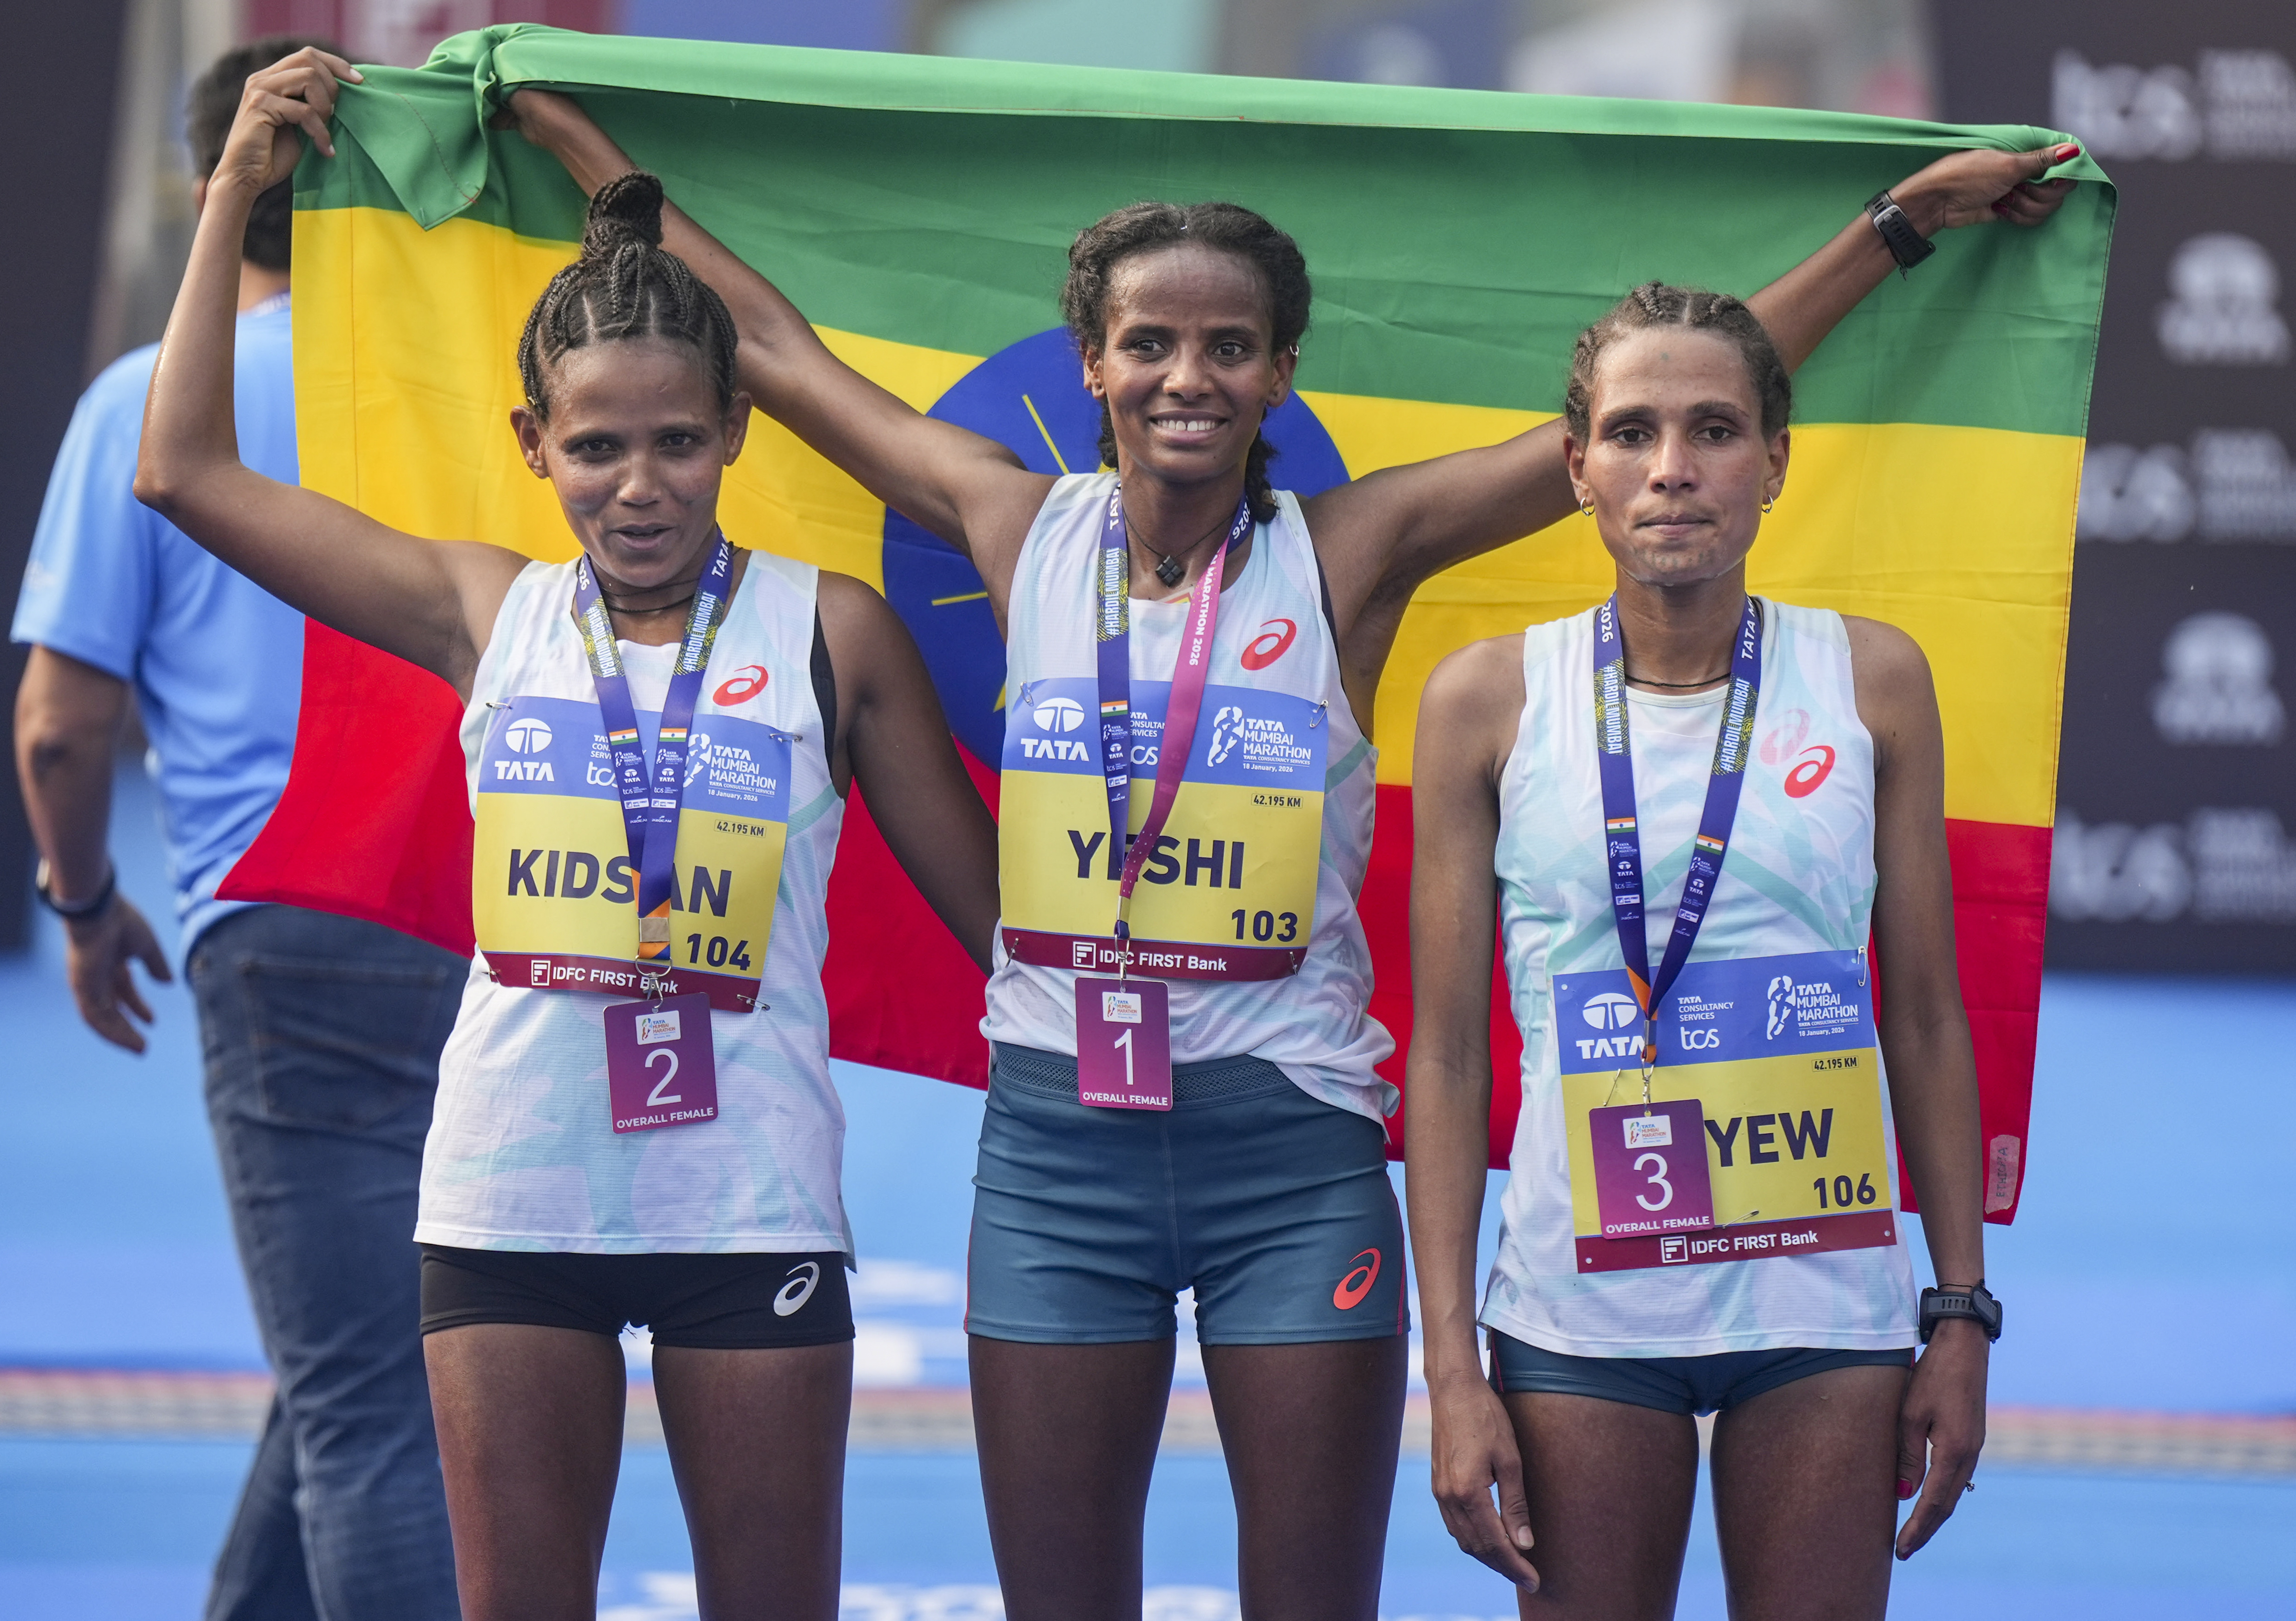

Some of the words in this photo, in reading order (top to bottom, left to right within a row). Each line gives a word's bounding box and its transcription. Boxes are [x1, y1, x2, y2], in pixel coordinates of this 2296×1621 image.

[1195, 566, 1214, 635] MARATHON
[1601, 601, 1614, 643] 2026
[1741, 620, 1756, 660] TATA
[1189, 638, 1203, 666] 2026
[1130, 712, 1148, 720] ATA
[1130, 729, 1158, 737] RVICES
[1247, 719, 1285, 733] TATA
[1245, 730, 1293, 745] MUMBAI
[714, 745, 751, 761] TATA
[1021, 738, 1089, 762] TATA
[1130, 745, 1159, 766] cs
[1244, 743, 1311, 760] MARATHON
[495, 760, 555, 782] TATA
[711, 756, 760, 775] MUMBAI
[1251, 764, 1278, 773] January,
[709, 768, 777, 790] MARATHON
[723, 783, 755, 792] CONSULTANCY
[715, 790, 742, 800] January,
[1254, 795, 1285, 806] 42.195
[1287, 797, 1301, 808] KM
[717, 821, 748, 834] 42.195
[750, 826, 764, 836] KM
[1689, 887, 1704, 895] TATA
[1232, 910, 1298, 942] 103
[687, 933, 751, 971] 104
[1139, 951, 1183, 969] FIRST
[1188, 957, 1227, 972] Bank
[552, 966, 586, 981] IDFC
[590, 969, 637, 988] FIRST
[640, 978, 678, 994] Bnk
[1797, 982, 1832, 996] TATA
[1678, 996, 1702, 1004] TATA
[1678, 1002, 1734, 1013] CONSULTANCY
[1797, 993, 1841, 1010] MUMBAI
[1679, 1012, 1715, 1022] SERVICES
[1797, 1005, 1858, 1021] MARATHON
[1680, 1026, 1720, 1050] tcs
[1806, 1028, 1831, 1037] January,
[1576, 1035, 1645, 1059] TATA
[1114, 1029, 1133, 1085] 1
[1814, 1058, 1842, 1070] 42.195
[1844, 1057, 1857, 1068] KM
[644, 1048, 682, 1107] 2
[1083, 1091, 1127, 1104] OVERALL
[1129, 1094, 1168, 1106] FEMALE
[617, 1112, 668, 1129] OVERALL
[670, 1107, 714, 1122] FEMALE
[1633, 1153, 1674, 1211] 3
[1813, 1173, 1877, 1209] 106
[1606, 1220, 1661, 1234] OVERALL
[1663, 1216, 1710, 1229] FEMALE
[1691, 1238, 1730, 1255] IDFC
[1734, 1235, 1777, 1251] FIRST
[1781, 1231, 1819, 1245] Bank
